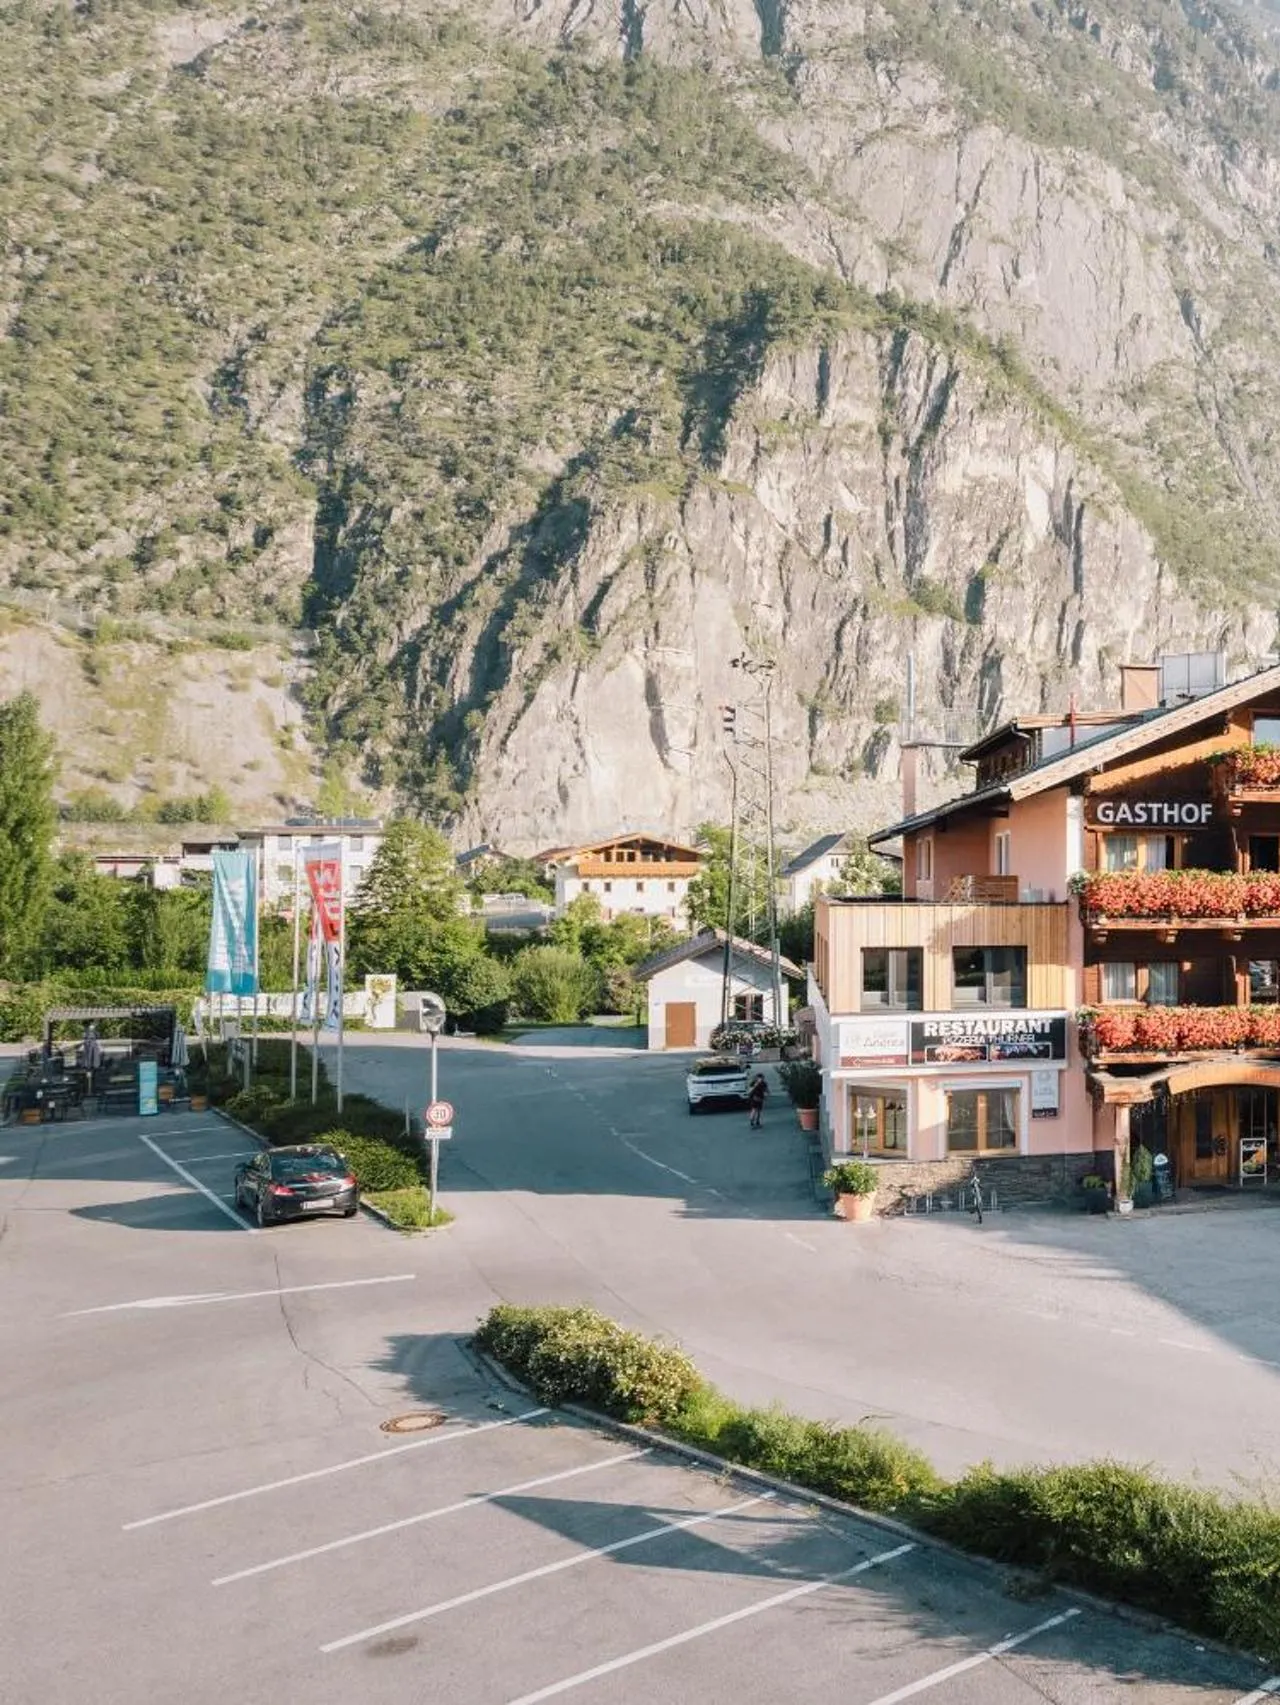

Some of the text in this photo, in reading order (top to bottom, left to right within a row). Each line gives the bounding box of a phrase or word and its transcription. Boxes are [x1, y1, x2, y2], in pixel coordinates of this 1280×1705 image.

[1096, 801, 1213, 824] GASTHOF
[923, 1018, 1053, 1037] RESTAURANT
[942, 1035, 987, 1045] PIZZERIA
[433, 1109, 446, 1119] 30
